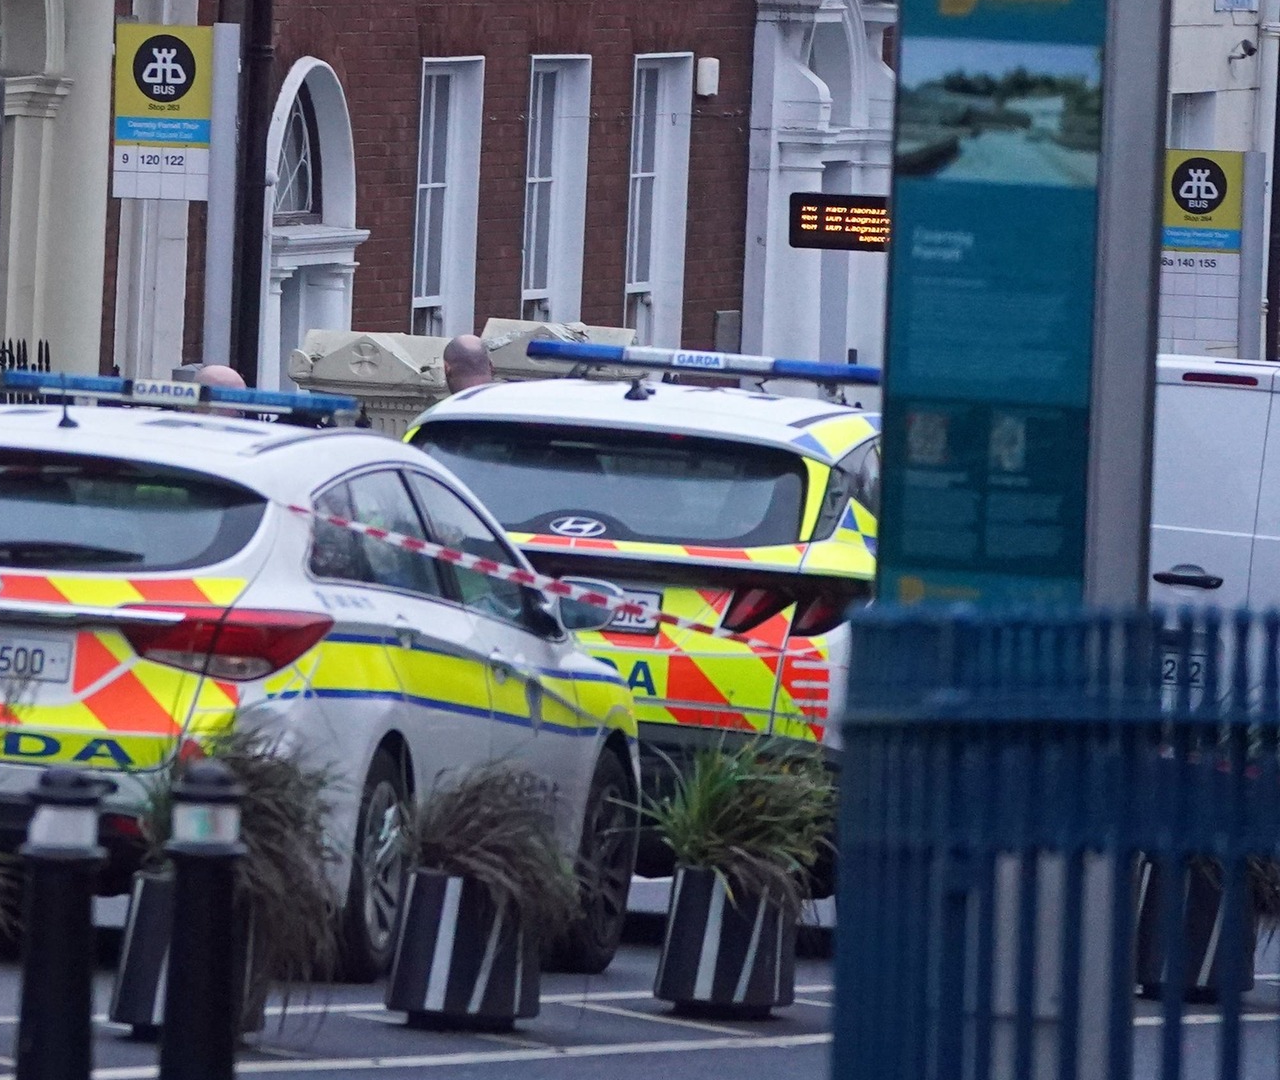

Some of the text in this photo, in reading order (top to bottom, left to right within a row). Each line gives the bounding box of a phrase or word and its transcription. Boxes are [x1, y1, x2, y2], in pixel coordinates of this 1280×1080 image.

[153, 85, 176, 95] BUS
[148, 103, 165, 111] Stop
[122, 154, 184, 166] 9 120 122
[1188, 200, 1208, 209] BUS
[1177, 258, 1195, 267] 140
[1200, 259, 1216, 268] 155
[677, 353, 720, 366] GARDA
[136, 383, 195, 397] GARDA
